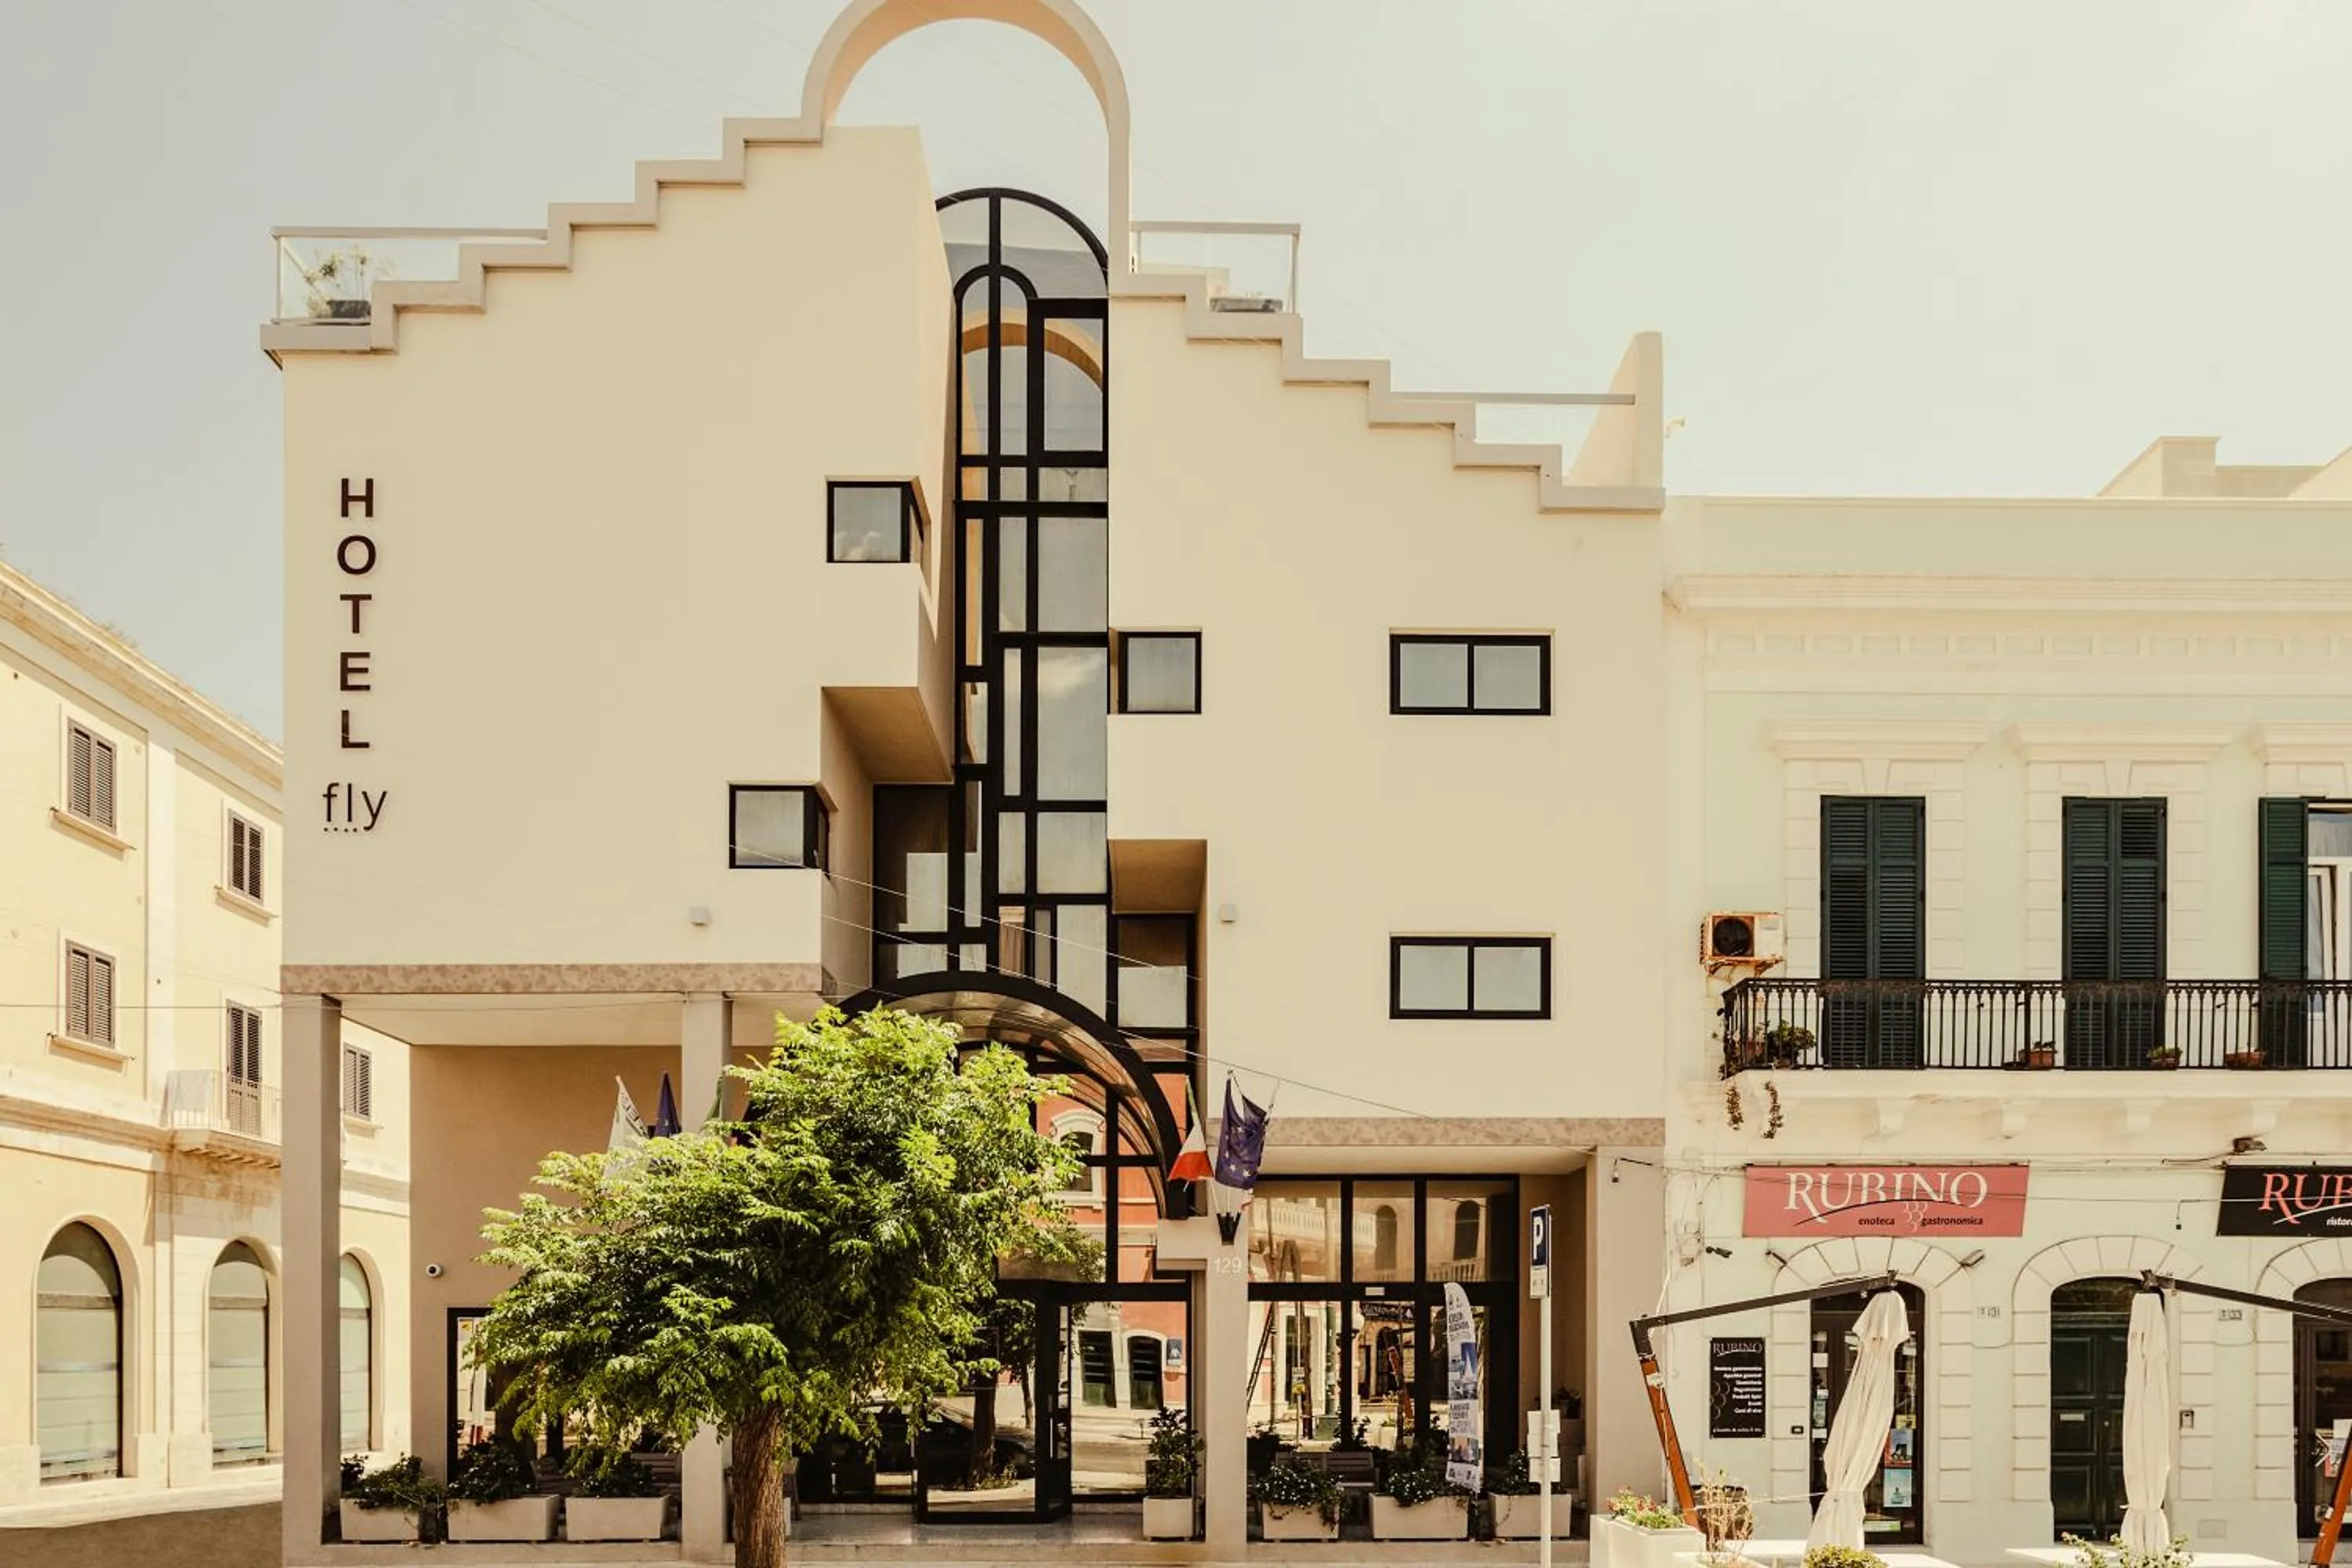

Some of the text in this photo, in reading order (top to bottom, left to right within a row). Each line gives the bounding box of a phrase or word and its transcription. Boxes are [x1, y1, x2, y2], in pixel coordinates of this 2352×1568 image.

[337, 477, 376, 749] HOTEL
[322, 782, 387, 830] fly
[1784, 1171, 1987, 1224] RUBINO
[1533, 1216, 1544, 1260] P
[1858, 1216, 1983, 1227] enoteca gastronomica
[1214, 1257, 1242, 1273] 129
[1713, 1341, 1762, 1355] RUBINO
